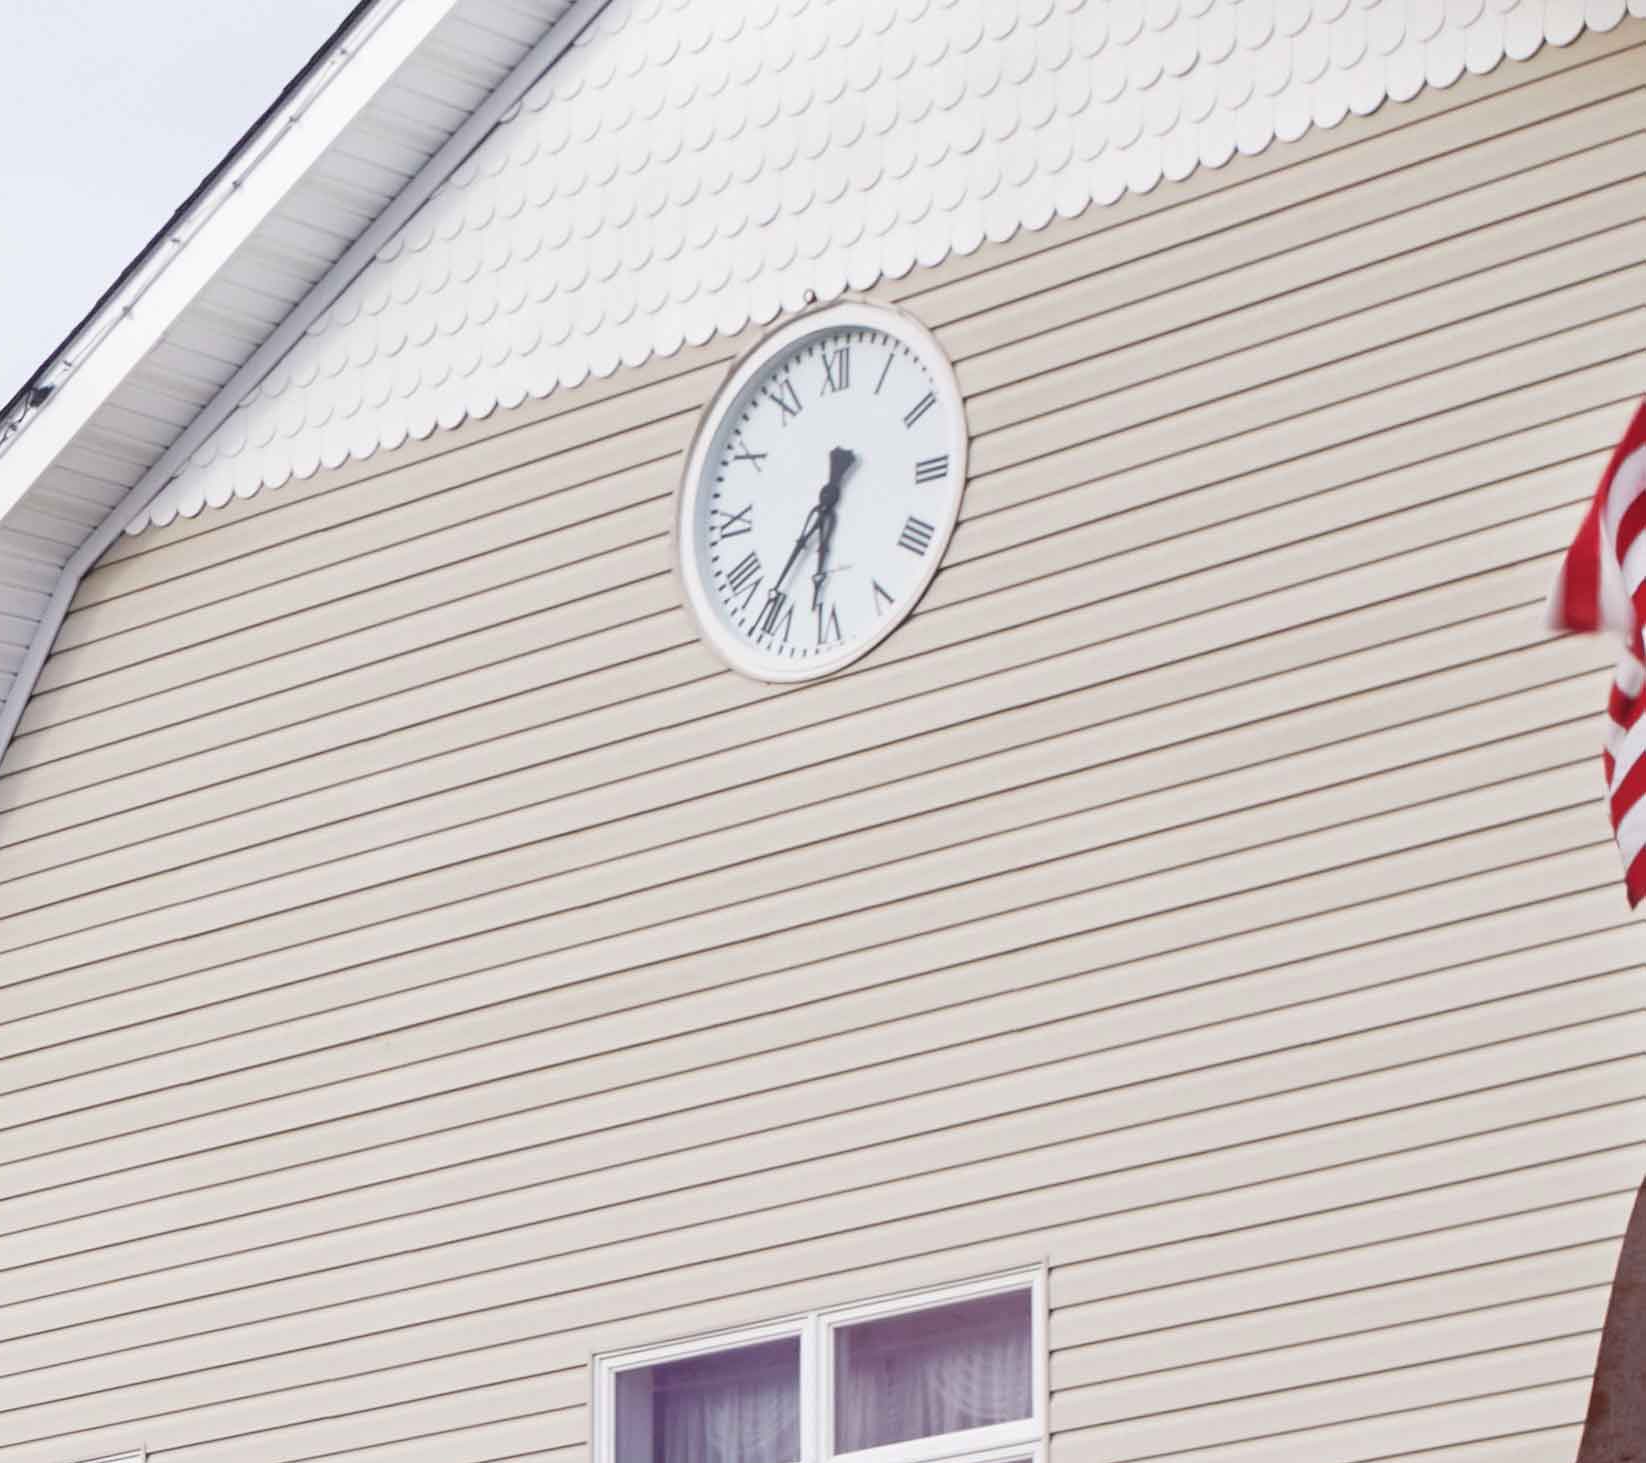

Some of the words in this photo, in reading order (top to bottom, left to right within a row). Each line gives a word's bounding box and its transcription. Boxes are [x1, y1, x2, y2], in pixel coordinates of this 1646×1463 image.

[821, 347, 849, 397] XII
[770, 378, 803, 426] XI
[903, 392, 937, 429] II
[734, 443, 766, 472] X
[915, 454, 948, 484] III
[720, 504, 753, 538] IX
[898, 516, 934, 557] IIII
[727, 551, 764, 609] VIII
[872, 579, 894, 616] V
[818, 602, 841, 644] VI
